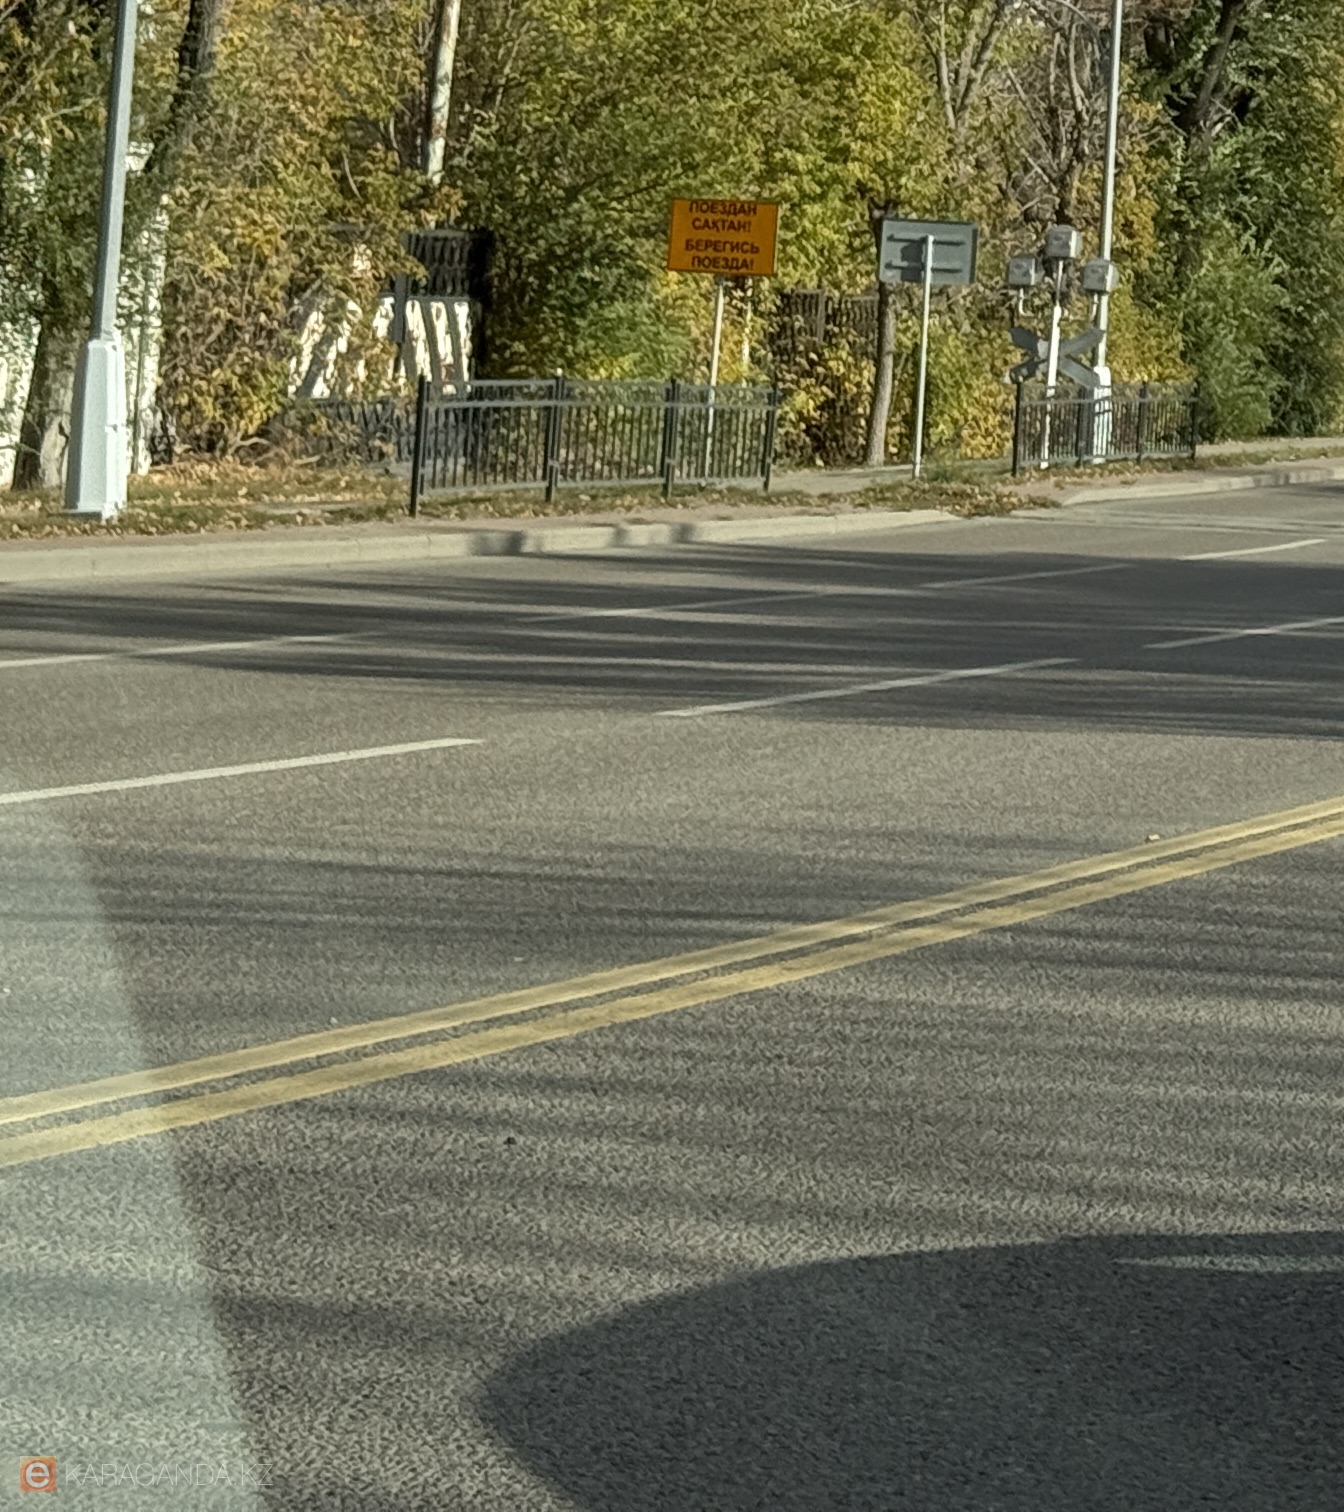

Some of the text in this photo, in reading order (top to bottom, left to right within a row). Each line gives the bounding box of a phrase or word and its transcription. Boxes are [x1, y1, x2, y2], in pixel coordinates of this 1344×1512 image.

[689, 200, 757, 217] ПОЕЗДАН
[691, 217, 752, 233] САҚТАН!
[685, 238, 760, 255] БЕРЕГИСЬ
[691, 255, 754, 271] ПОЕЗДА!
